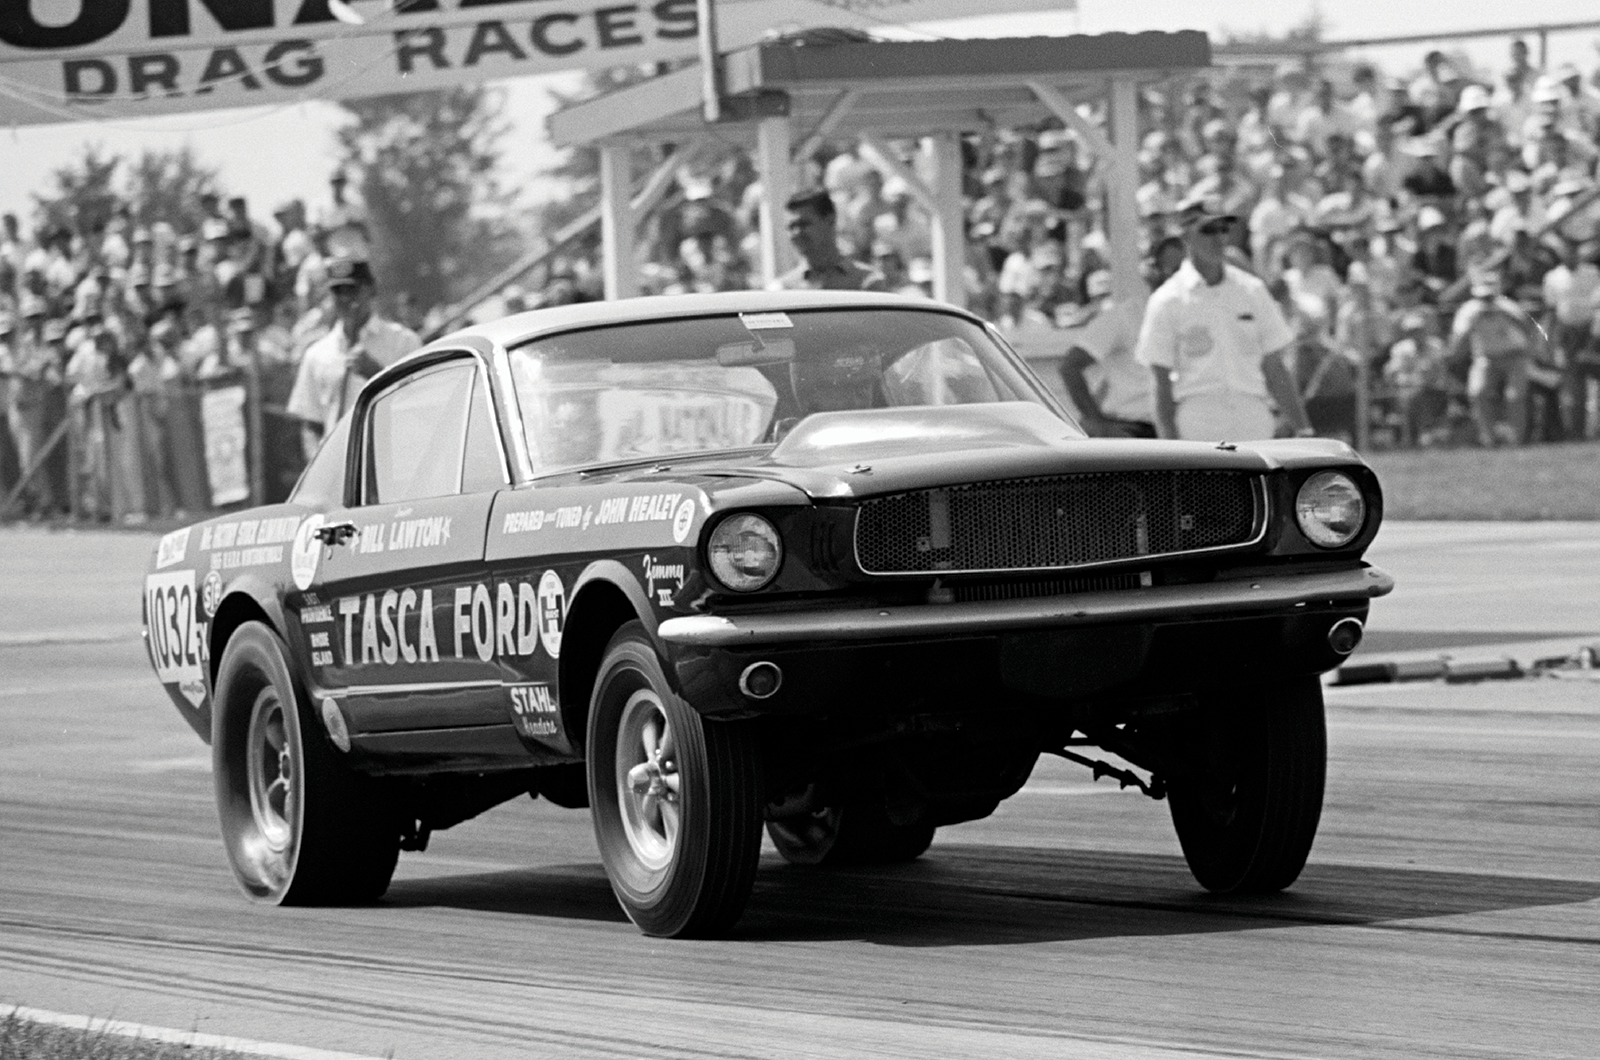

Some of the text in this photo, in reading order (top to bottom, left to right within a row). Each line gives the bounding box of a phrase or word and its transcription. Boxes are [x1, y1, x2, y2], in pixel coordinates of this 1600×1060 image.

[62, 39, 325, 99] DRAG
[393, 0, 698, 72] RACES
[595, 497, 629, 525] JOHN
[628, 493, 682, 522] HEALEY
[149, 584, 197, 669] 1032
[339, 582, 538, 665] TASCA FORD
[510, 686, 557, 715] STAHL
